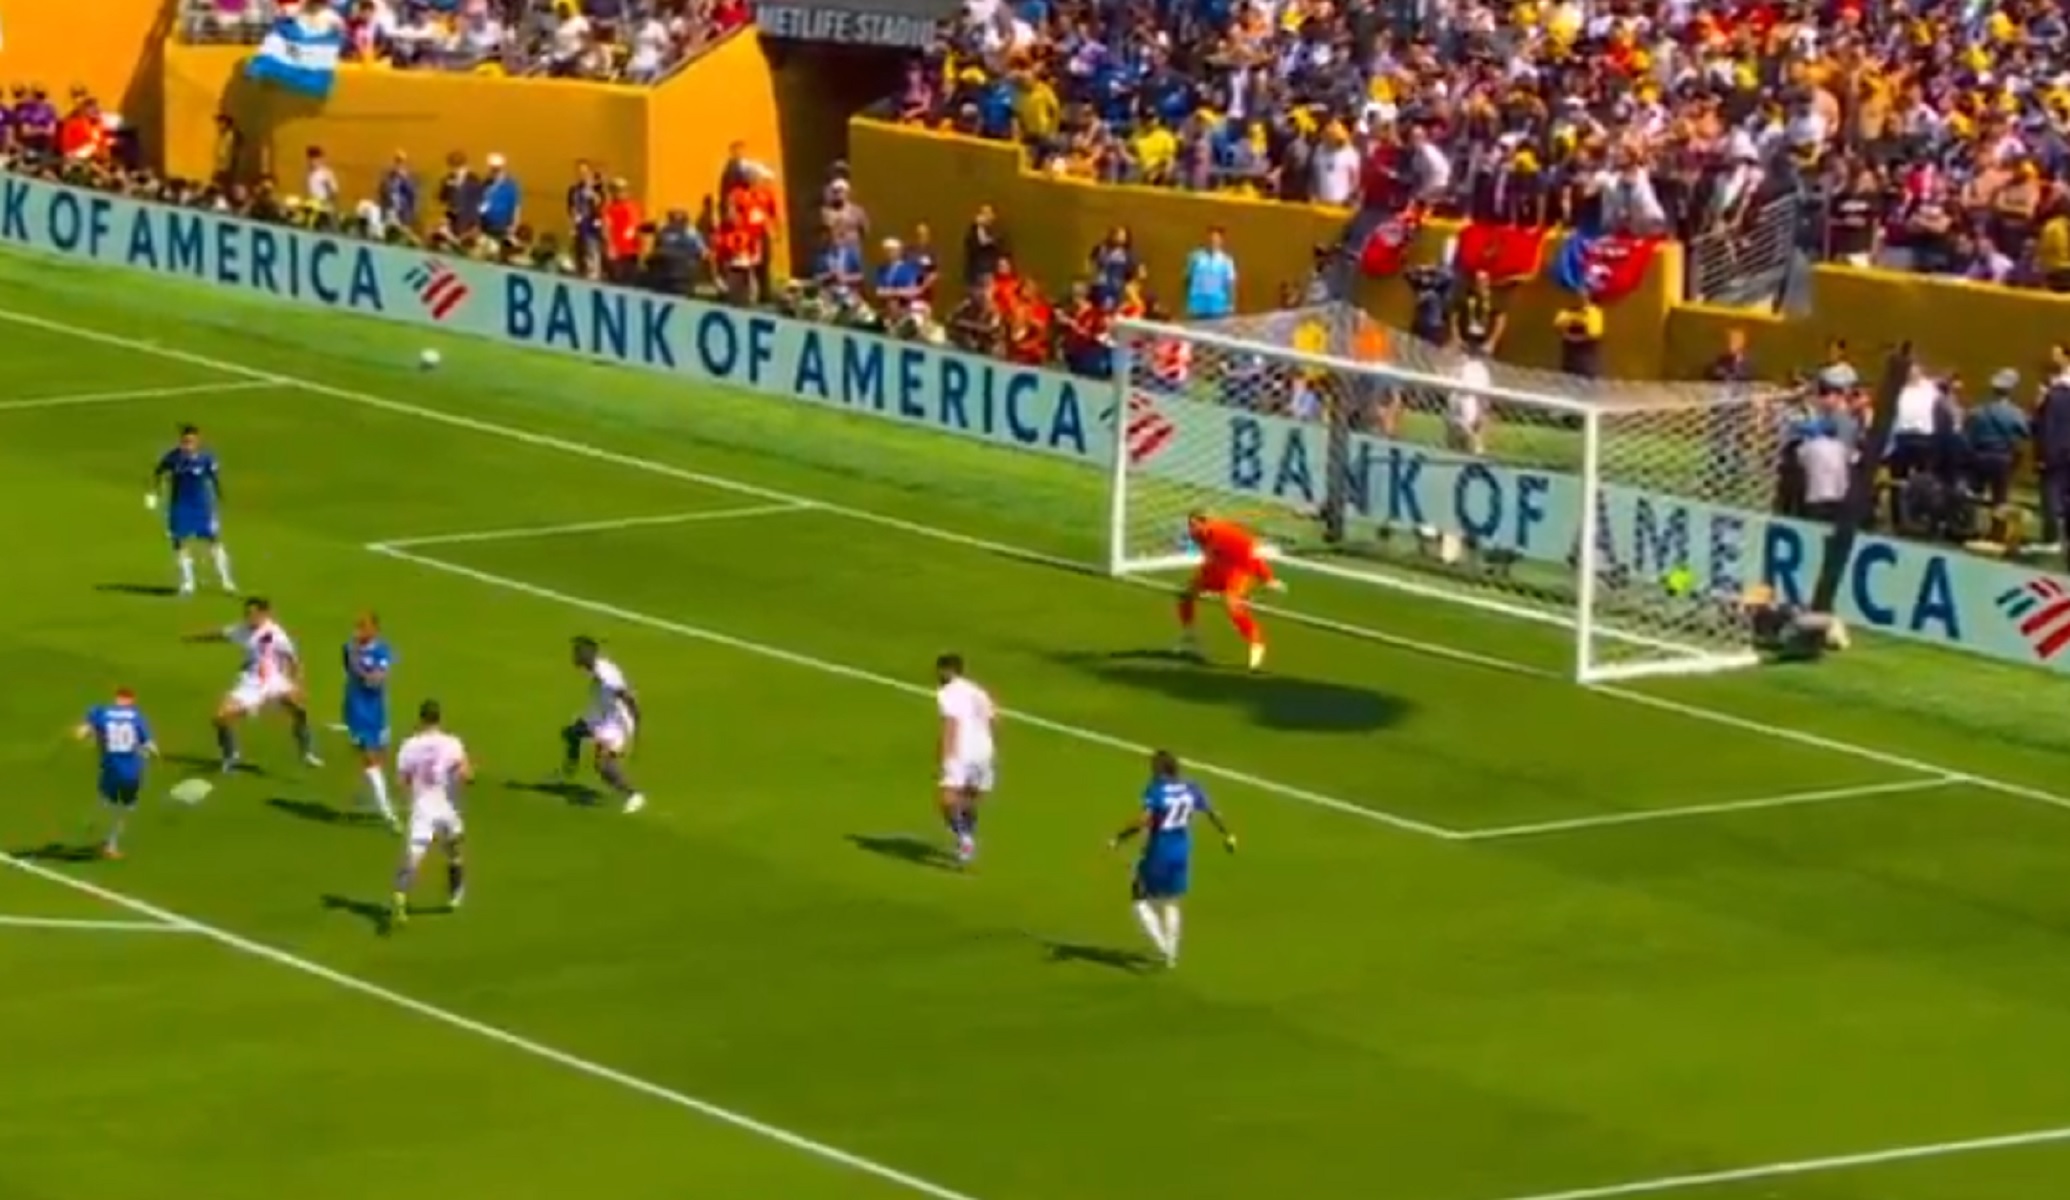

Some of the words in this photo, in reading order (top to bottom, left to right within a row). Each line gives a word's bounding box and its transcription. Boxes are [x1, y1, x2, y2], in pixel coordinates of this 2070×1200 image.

[48, 191, 112, 257] OF
[127, 208, 383, 311] AMERICA
[506, 273, 675, 368] BANK
[696, 311, 776, 393] OF
[795, 329, 1086, 455] AMERICA
[1455, 462, 1549, 548] OF
